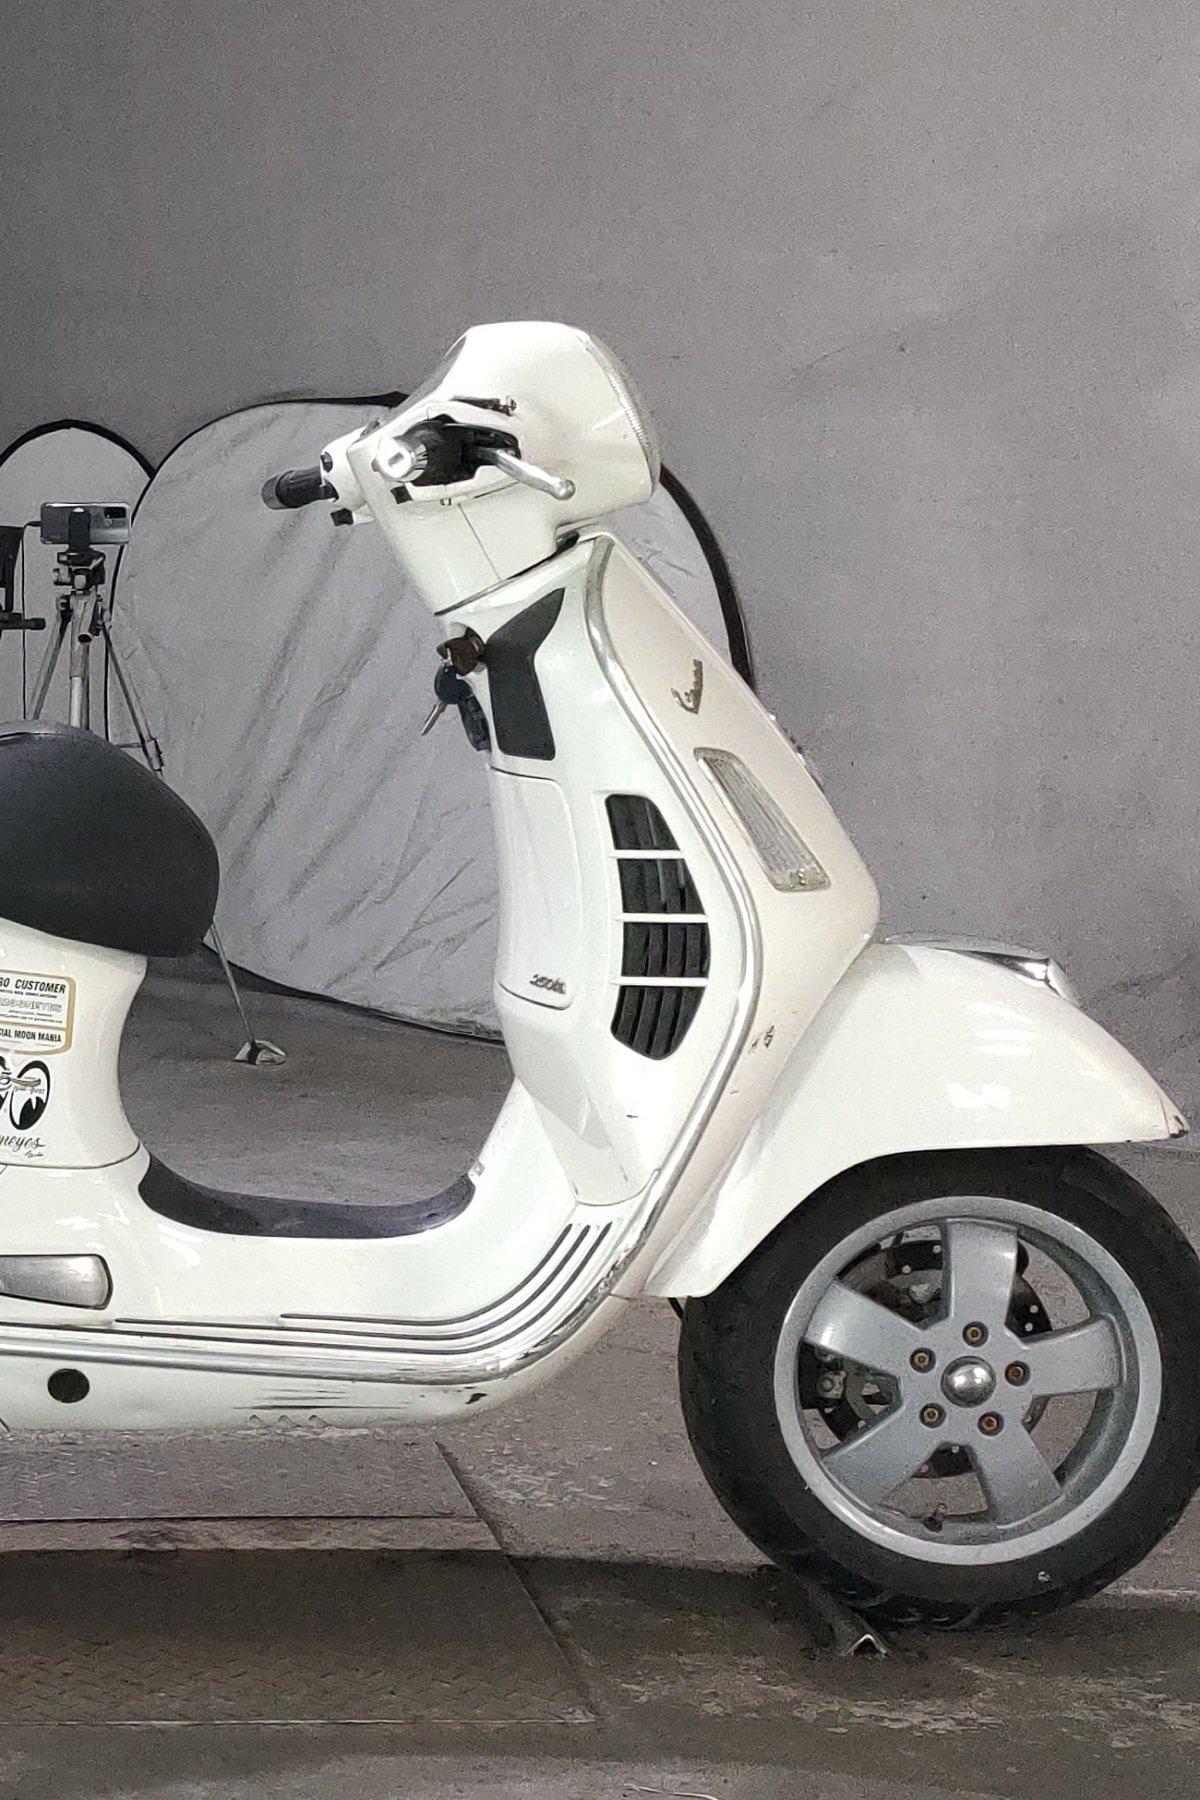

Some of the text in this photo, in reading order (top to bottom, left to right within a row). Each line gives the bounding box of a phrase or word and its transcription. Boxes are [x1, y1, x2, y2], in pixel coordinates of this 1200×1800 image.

[14, 978, 67, 994] CUSTOMER
[14, 1029, 36, 1041] MOON
[37, 1032, 63, 1043] MANIA
